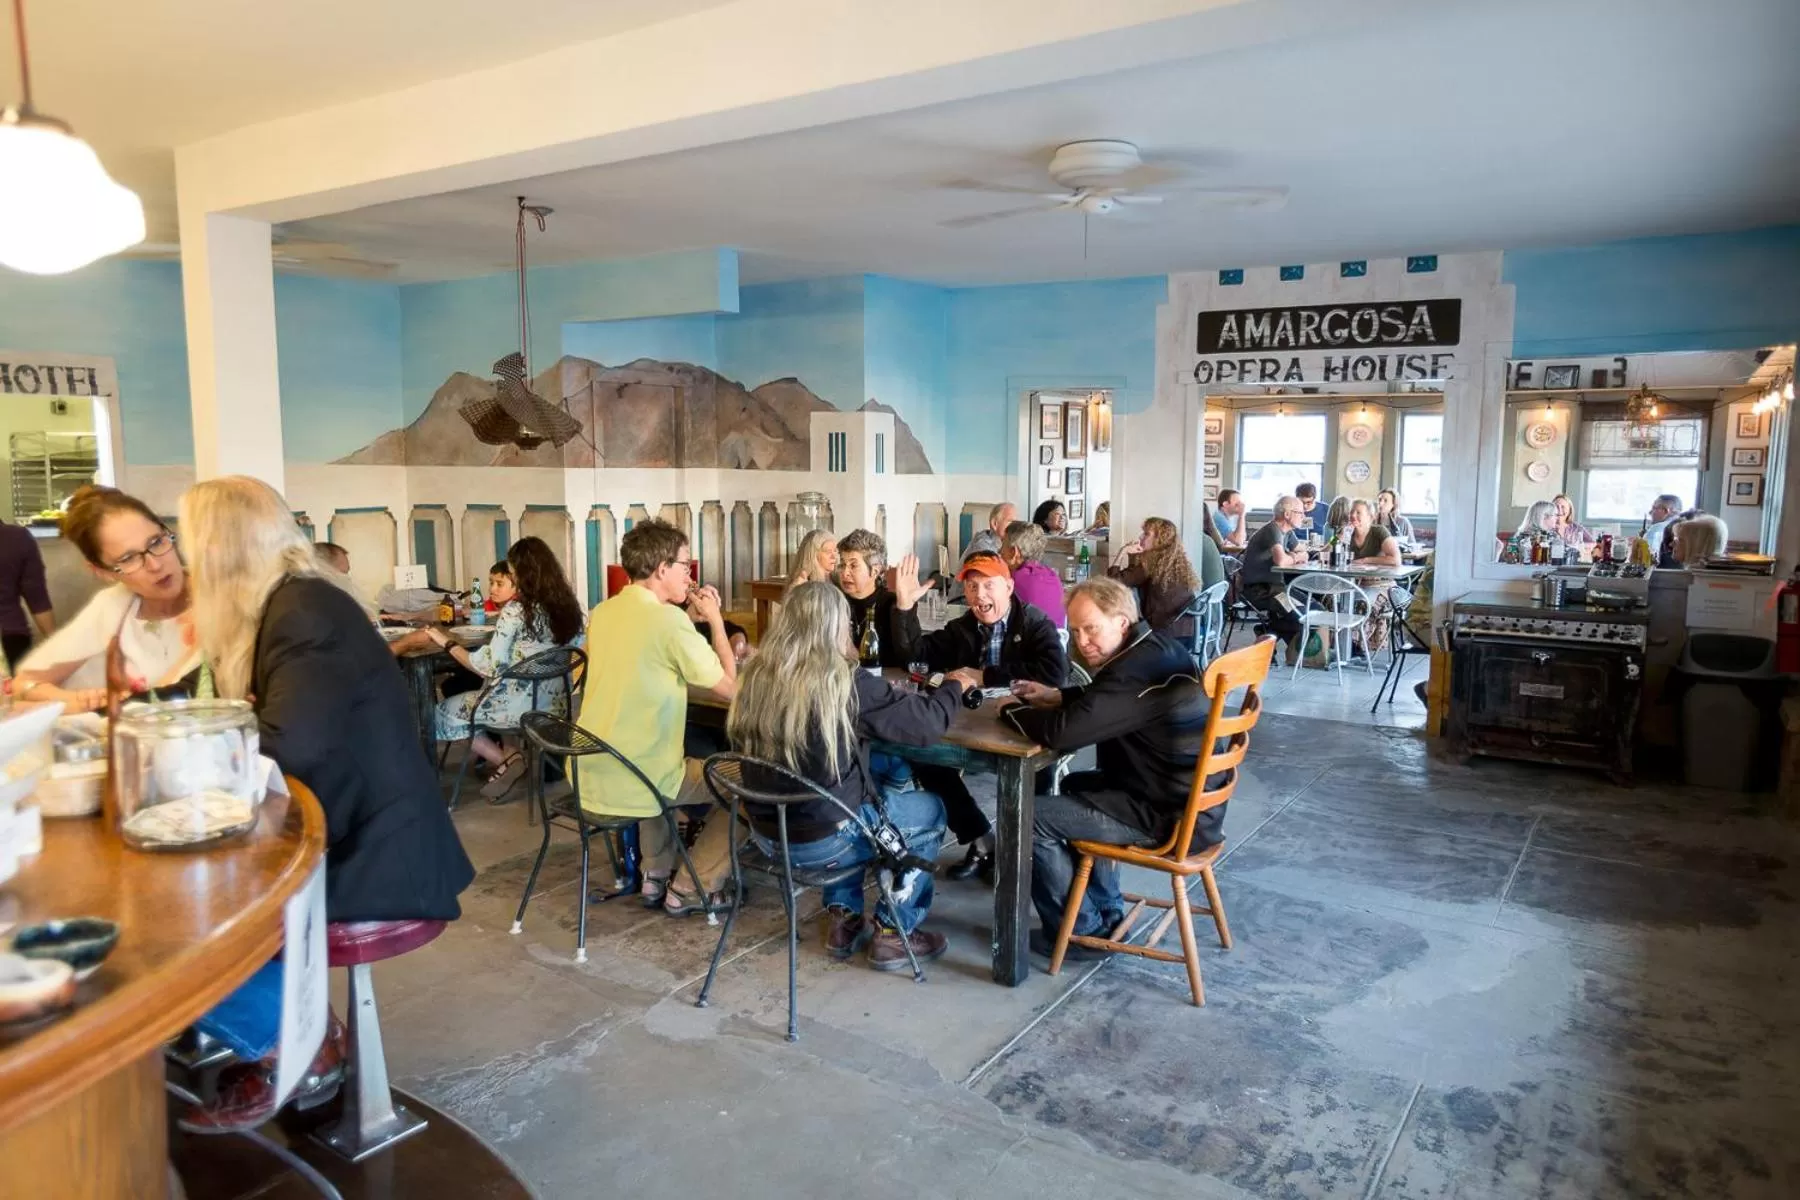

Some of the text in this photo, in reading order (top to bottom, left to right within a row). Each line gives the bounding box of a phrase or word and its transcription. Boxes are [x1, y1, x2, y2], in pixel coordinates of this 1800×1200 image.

[1217, 305, 1437, 349] AMARGOSA
[1193, 353, 1456, 384] OPERA HOUSE
